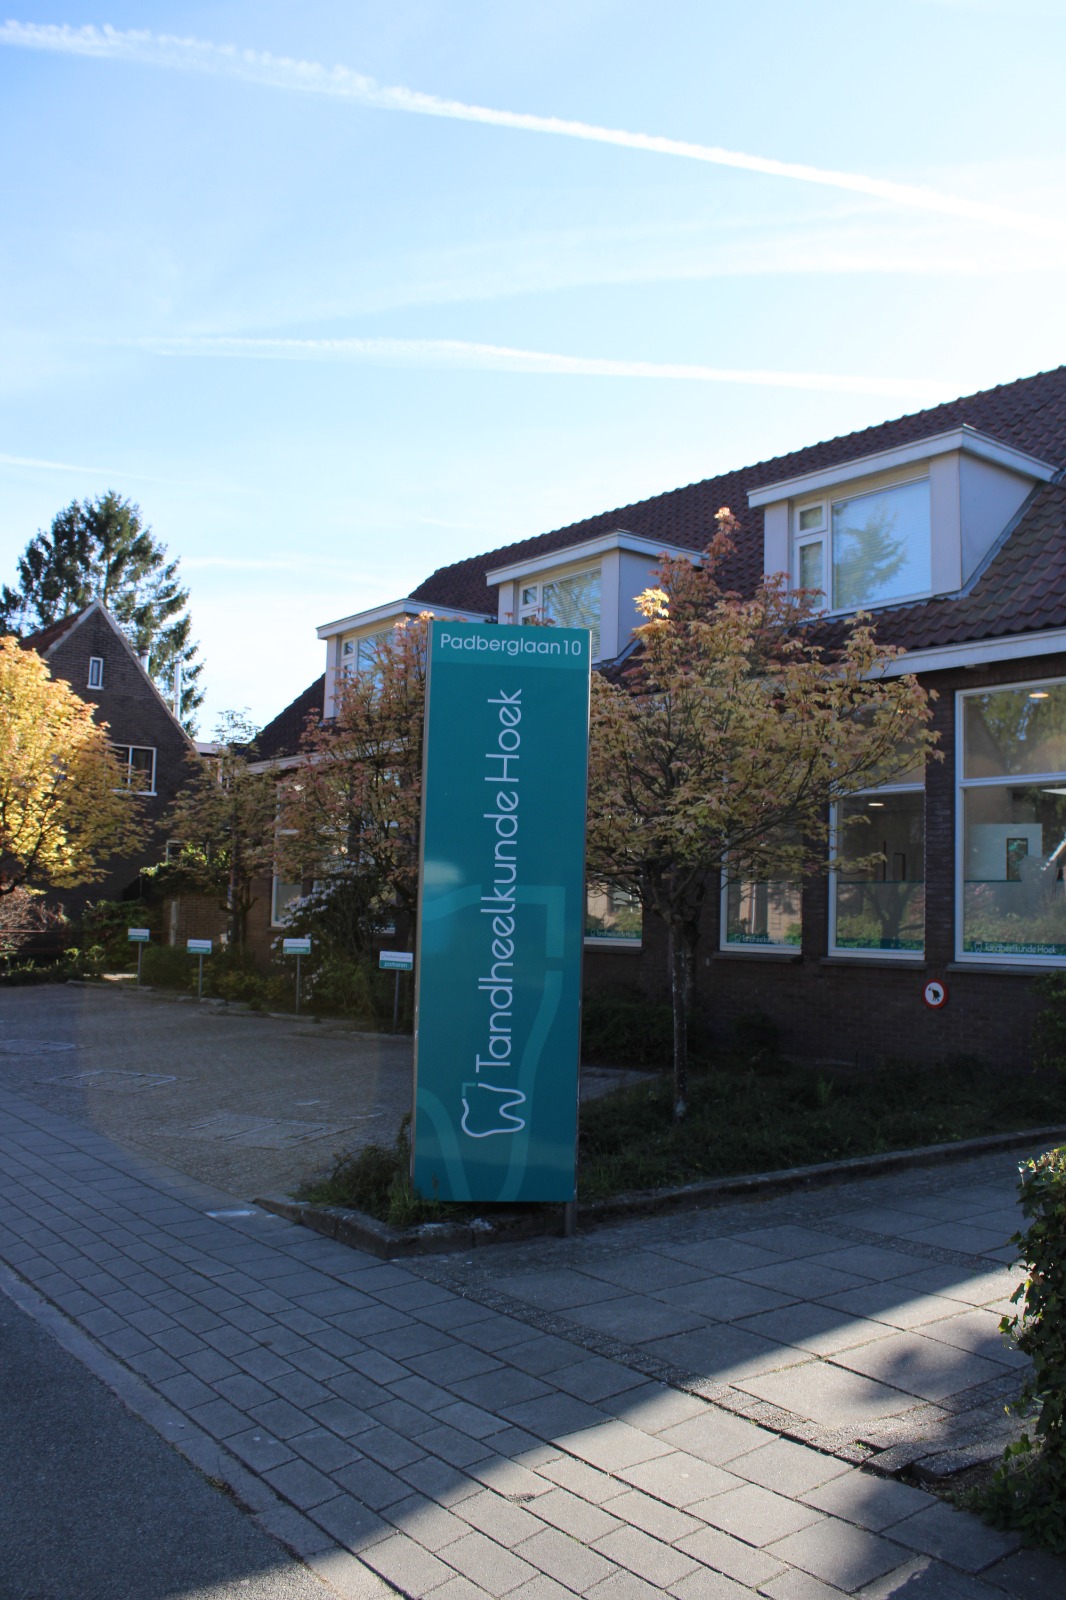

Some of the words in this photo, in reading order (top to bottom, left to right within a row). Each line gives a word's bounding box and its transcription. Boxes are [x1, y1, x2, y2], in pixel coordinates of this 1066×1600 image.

[484, 688, 522, 783] Hoek
[475, 790, 519, 1073] Tandheelkunde
[985, 943, 1036, 953] Tandheelkunde
[1038, 945, 1056, 954] Hoek
